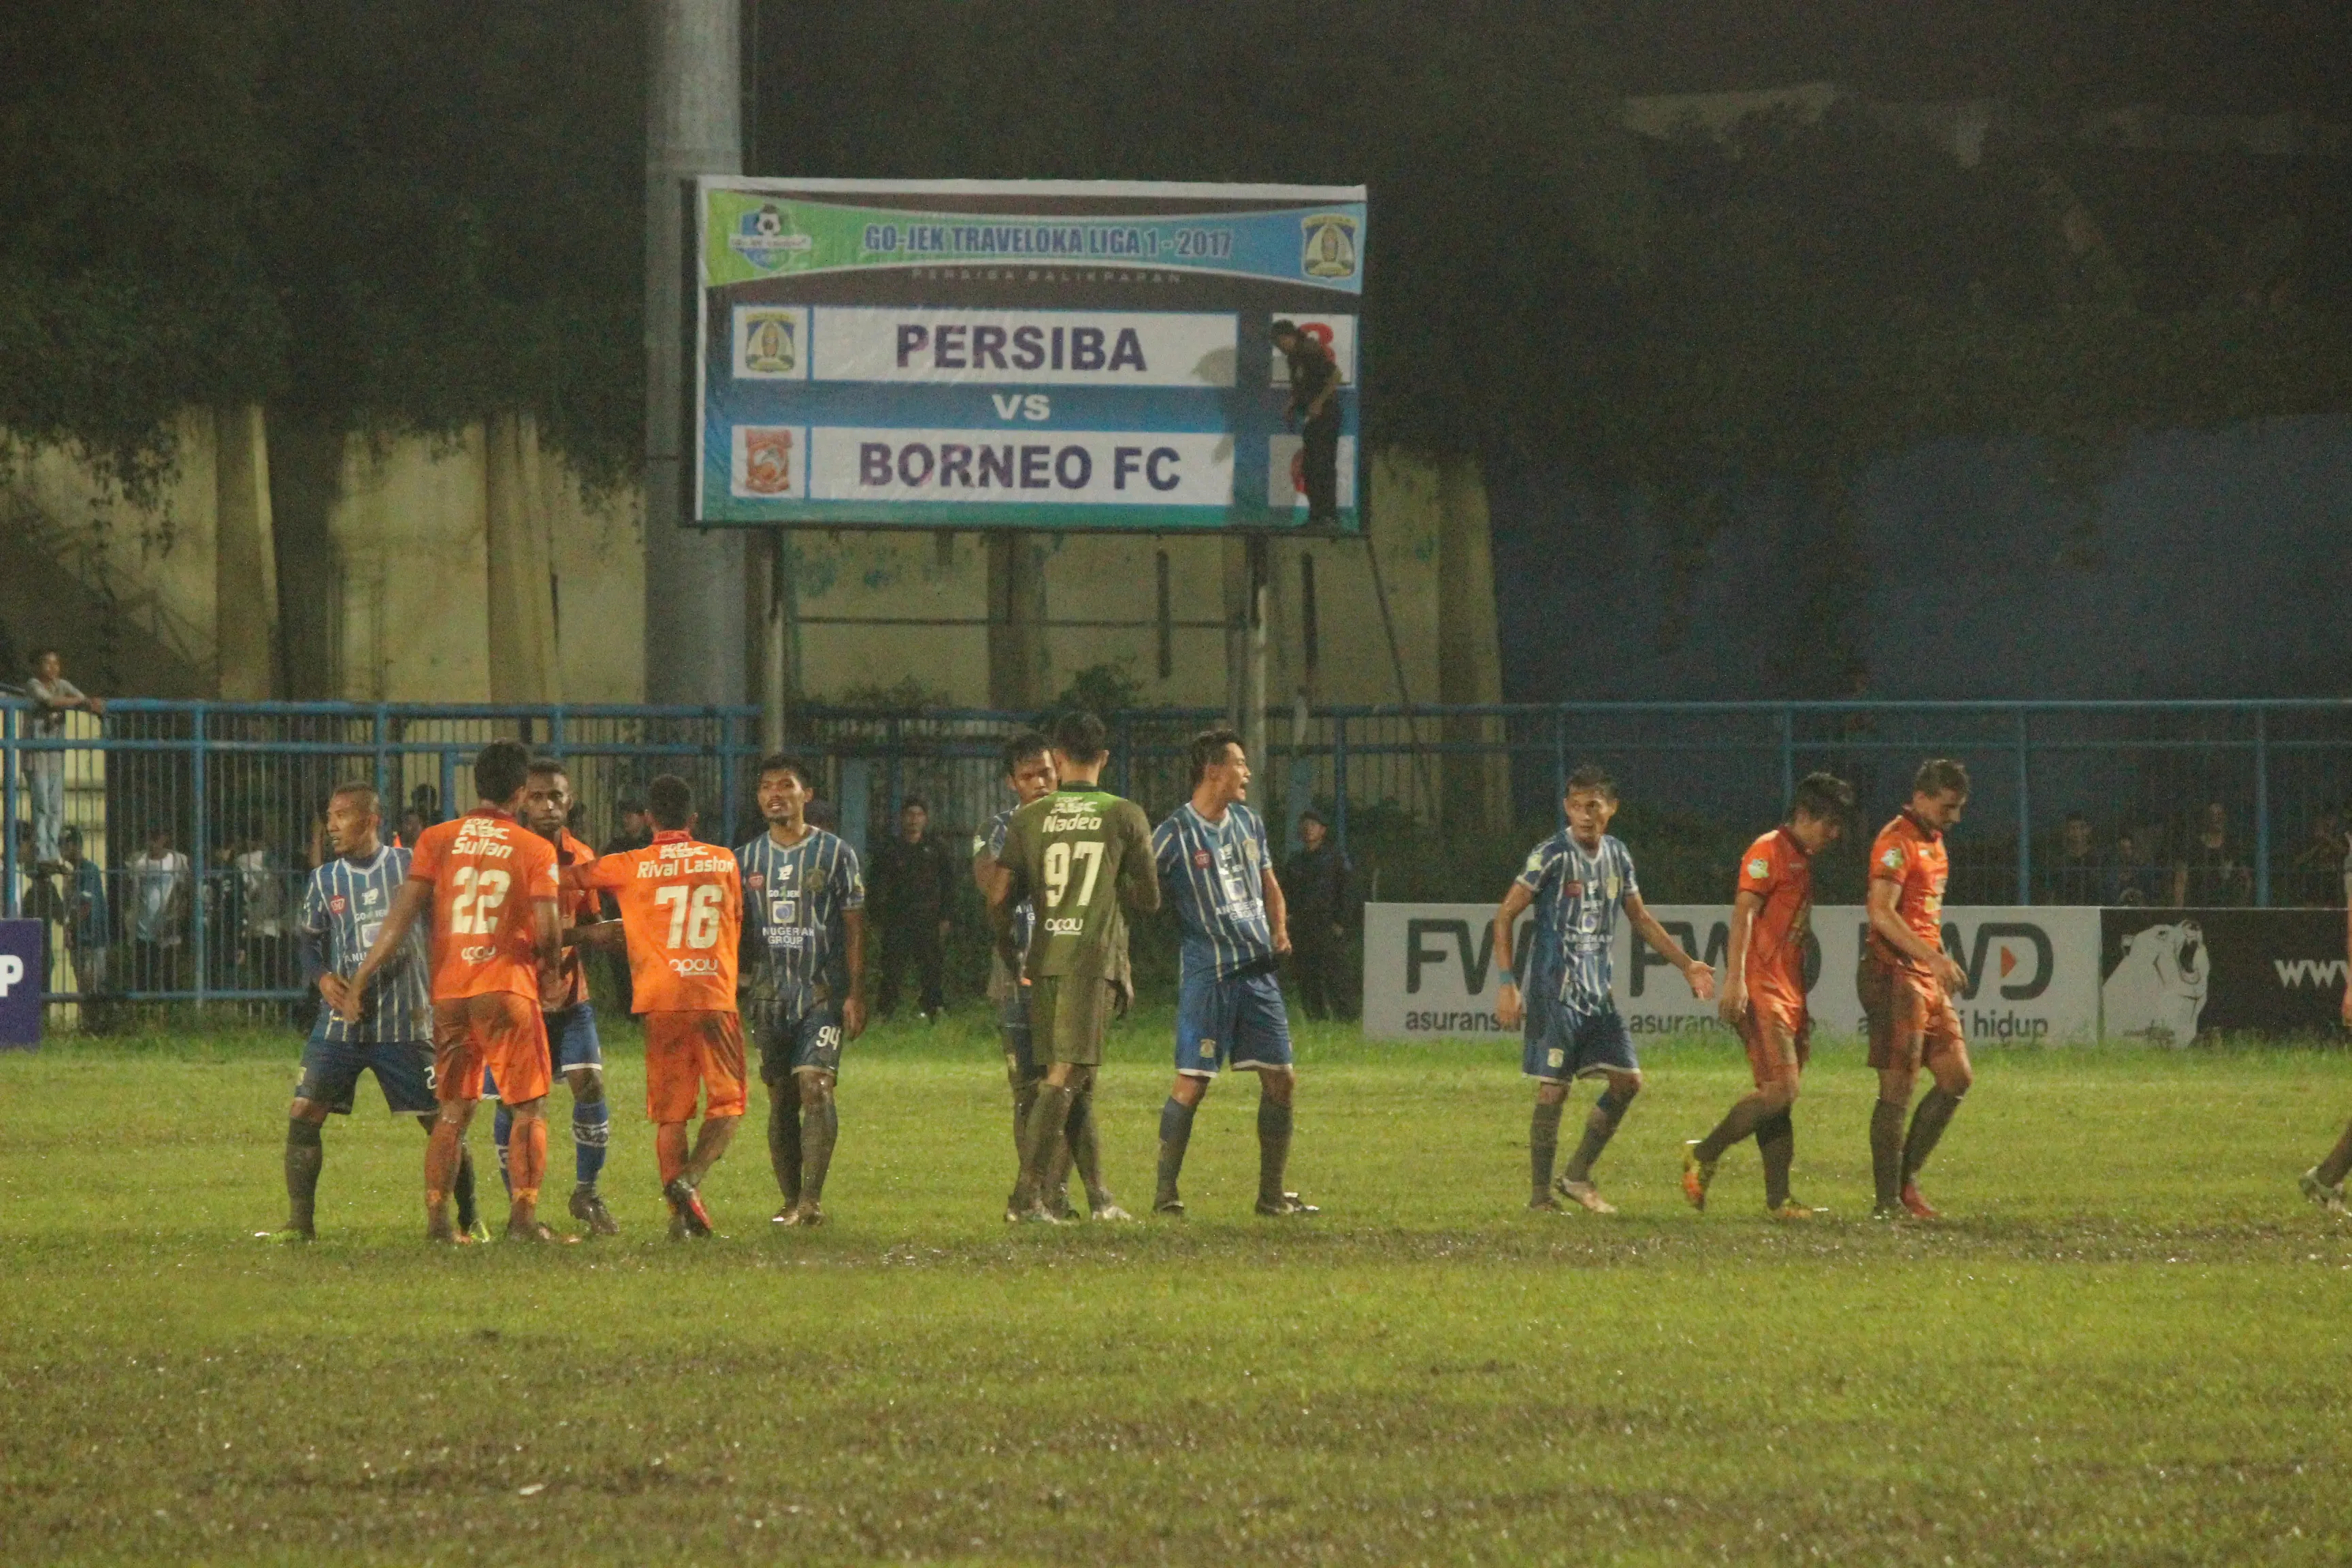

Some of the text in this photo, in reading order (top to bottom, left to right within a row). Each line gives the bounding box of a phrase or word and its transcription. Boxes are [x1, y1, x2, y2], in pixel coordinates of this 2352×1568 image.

[864, 225, 945, 252] GO-JEK
[953, 227, 1081, 254] TRAVELOKA
[1090, 228, 1139, 255] LIGA
[1178, 227, 1233, 257] 2017
[896, 323, 1147, 372] PERSIBA
[992, 393, 1051, 421] VS
[860, 442, 1181, 492] BORNEO FC
[459, 823, 510, 840] ABC
[1042, 813, 1102, 833] Nadeo
[636, 858, 680, 879] Rival
[1044, 841, 1105, 908] 97
[452, 866, 511, 934] 22
[654, 884, 723, 949] 76
[768, 935, 804, 945] GROUP
[815, 1025, 842, 1051] 94
[1974, 1010, 2049, 1043] hidup
